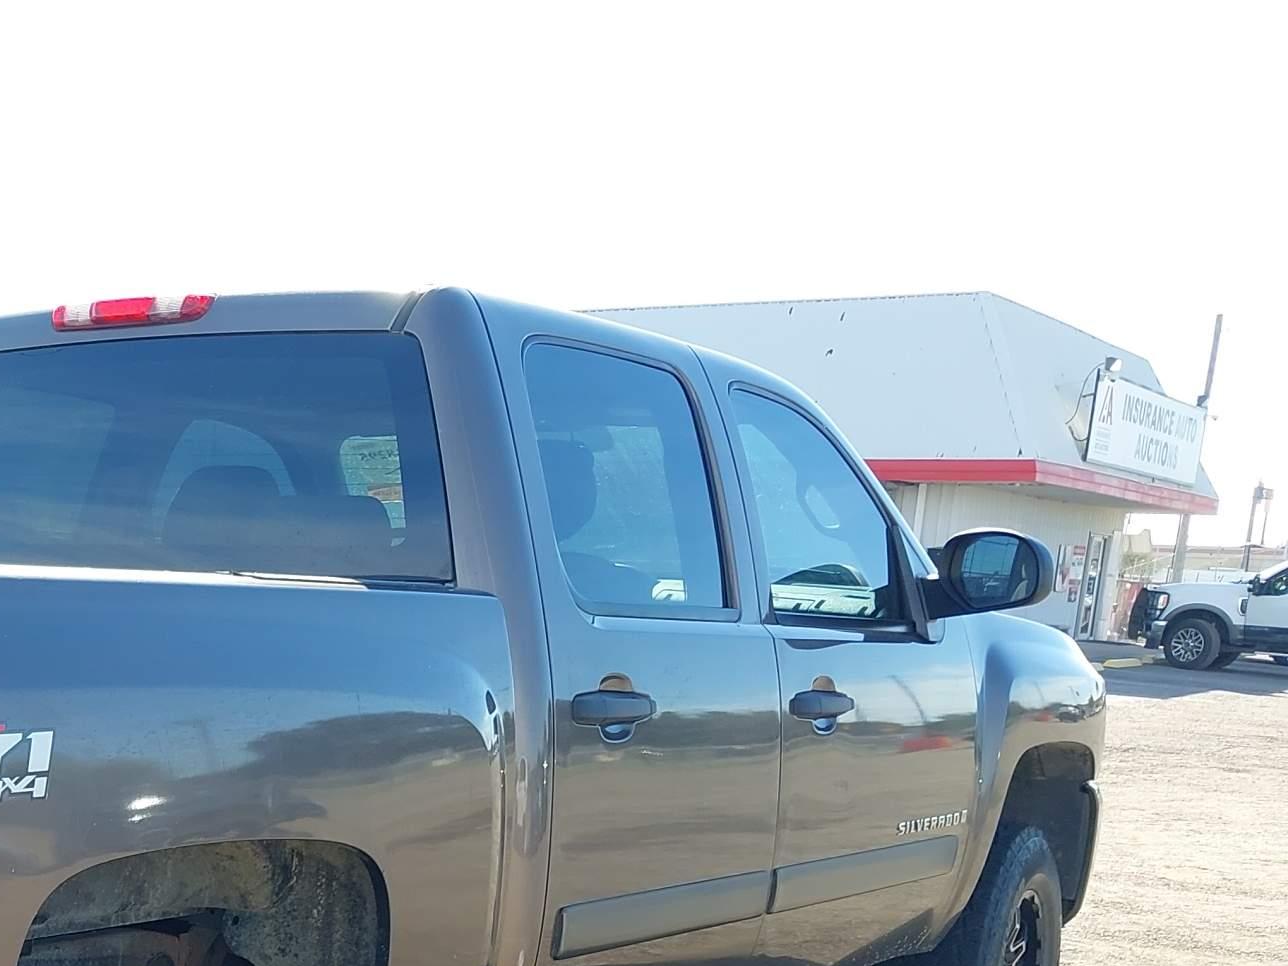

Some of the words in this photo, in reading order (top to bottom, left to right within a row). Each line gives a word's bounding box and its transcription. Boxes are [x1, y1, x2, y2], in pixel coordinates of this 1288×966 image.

[1121, 392, 1175, 436] INSURANCE
[1176, 414, 1198, 444] AUTO
[1134, 434, 1179, 470] AUCTIONS
